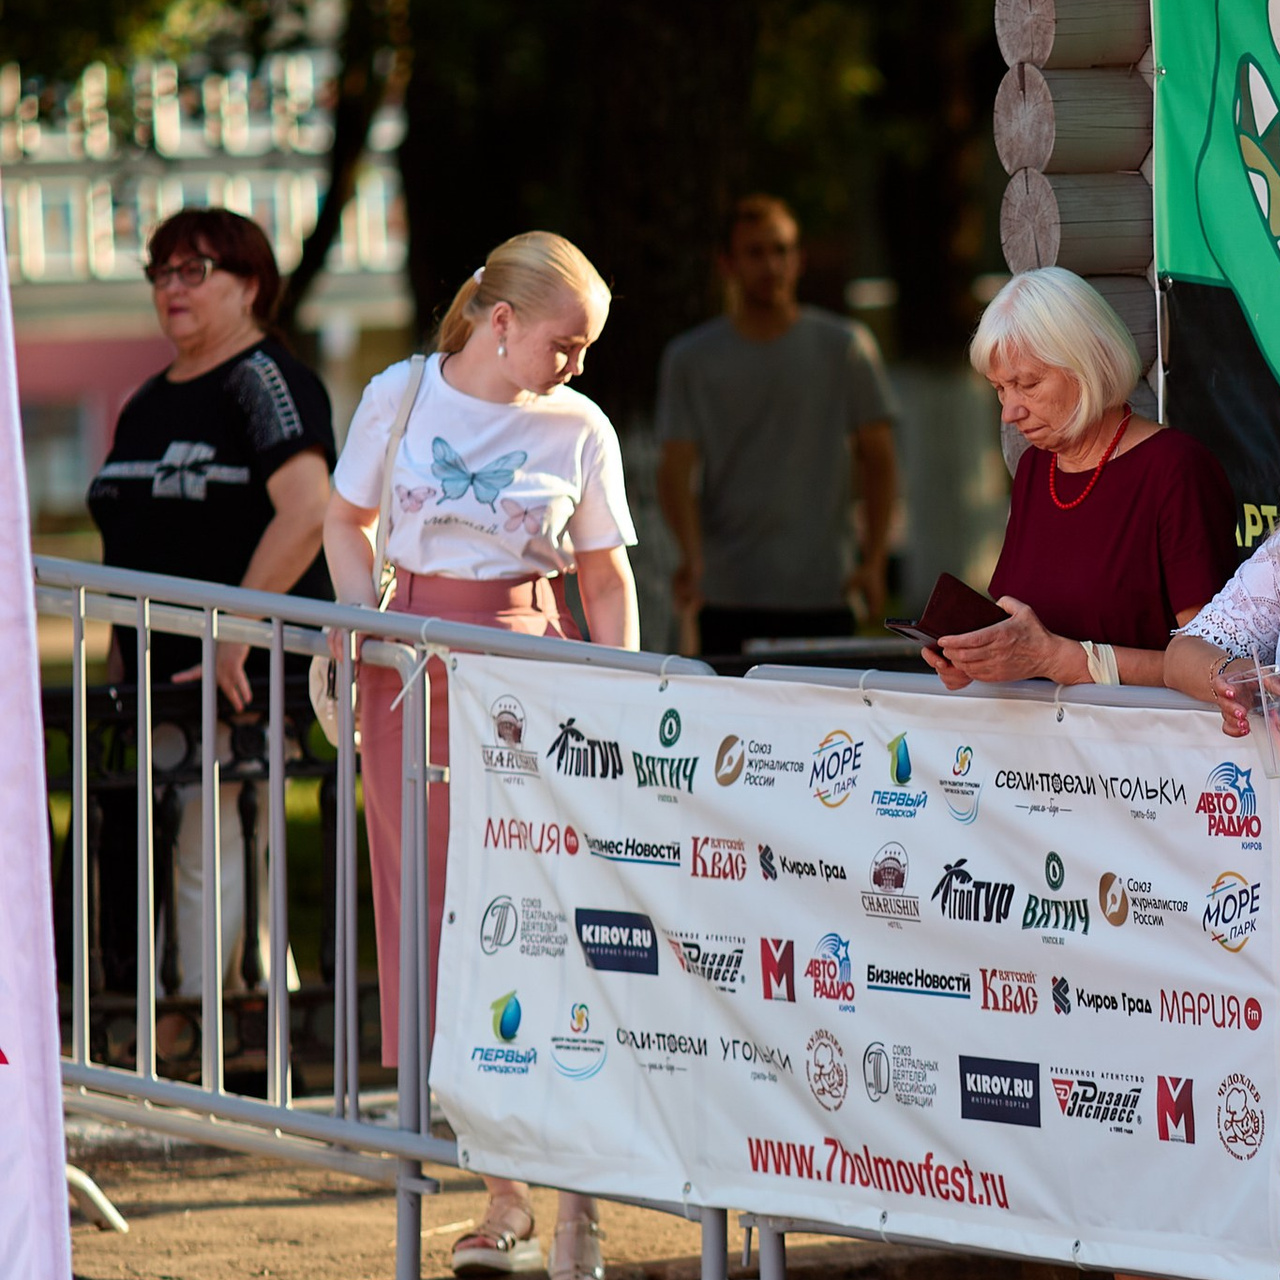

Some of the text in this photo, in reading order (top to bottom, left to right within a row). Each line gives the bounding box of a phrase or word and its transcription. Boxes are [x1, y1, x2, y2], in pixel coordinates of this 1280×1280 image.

[749, 740, 771, 754] Союз
[632, 751, 699, 794] ВЯТИЧ
[747, 759, 804, 773] журналистов
[809, 741, 864, 787] МОРЕ
[744, 772, 775, 787] России
[833, 776, 858, 795] ПАРК
[871, 789, 928, 808] ПЕРВЫЙ
[1195, 792, 1237, 814] АВТО
[876, 807, 916, 818] ГОРОДСКОЙ
[484, 817, 560, 854] МАРИЯ
[1208, 815, 1261, 838] РАДИО
[625, 838, 680, 860] Новости
[1241, 842, 1262, 850] КИРОВ
[779, 855, 847, 882] Киров Град
[1127, 878, 1151, 893] Союз
[861, 895, 920, 917] CHARUSHIN
[1130, 895, 1188, 912] журналистов
[1202, 883, 1260, 932] МОРЕ
[1022, 894, 1090, 935] ВЯТИЧ
[1134, 911, 1164, 926] России
[582, 924, 651, 948] KIROV.RU
[1229, 919, 1256, 940] ПАРК
[805, 959, 837, 979] АВТО
[867, 964, 970, 992] Бизнес Новости
[998, 970, 1036, 984] ВЯТСКИЙ
[813, 981, 855, 1003] РАДИО
[1076, 988, 1152, 1016] Киров Град
[1160, 989, 1240, 1029] МАРИЯ
[471, 1047, 537, 1064] ПЕРВЫЙ
[892, 1045, 911, 1057] СОЮЗ
[892, 1057, 939, 1071] ТЕАТРАЛЬНЫХ
[892, 1070, 927, 1082] ДЕЯТЕЛЕЙ
[1050, 1066, 1145, 1083] РЕКЛАМНОЕ АГЕНТСТВО
[893, 1082, 937, 1095] РОССИЙСКОЙ
[966, 1073, 1034, 1098] KIROV.RU
[895, 1094, 933, 1108] ФЕДЕРАЦИИ
[1067, 1091, 1134, 1124] Экспресс
[748, 1136, 1009, 1210] www.7holmovfest.ru
